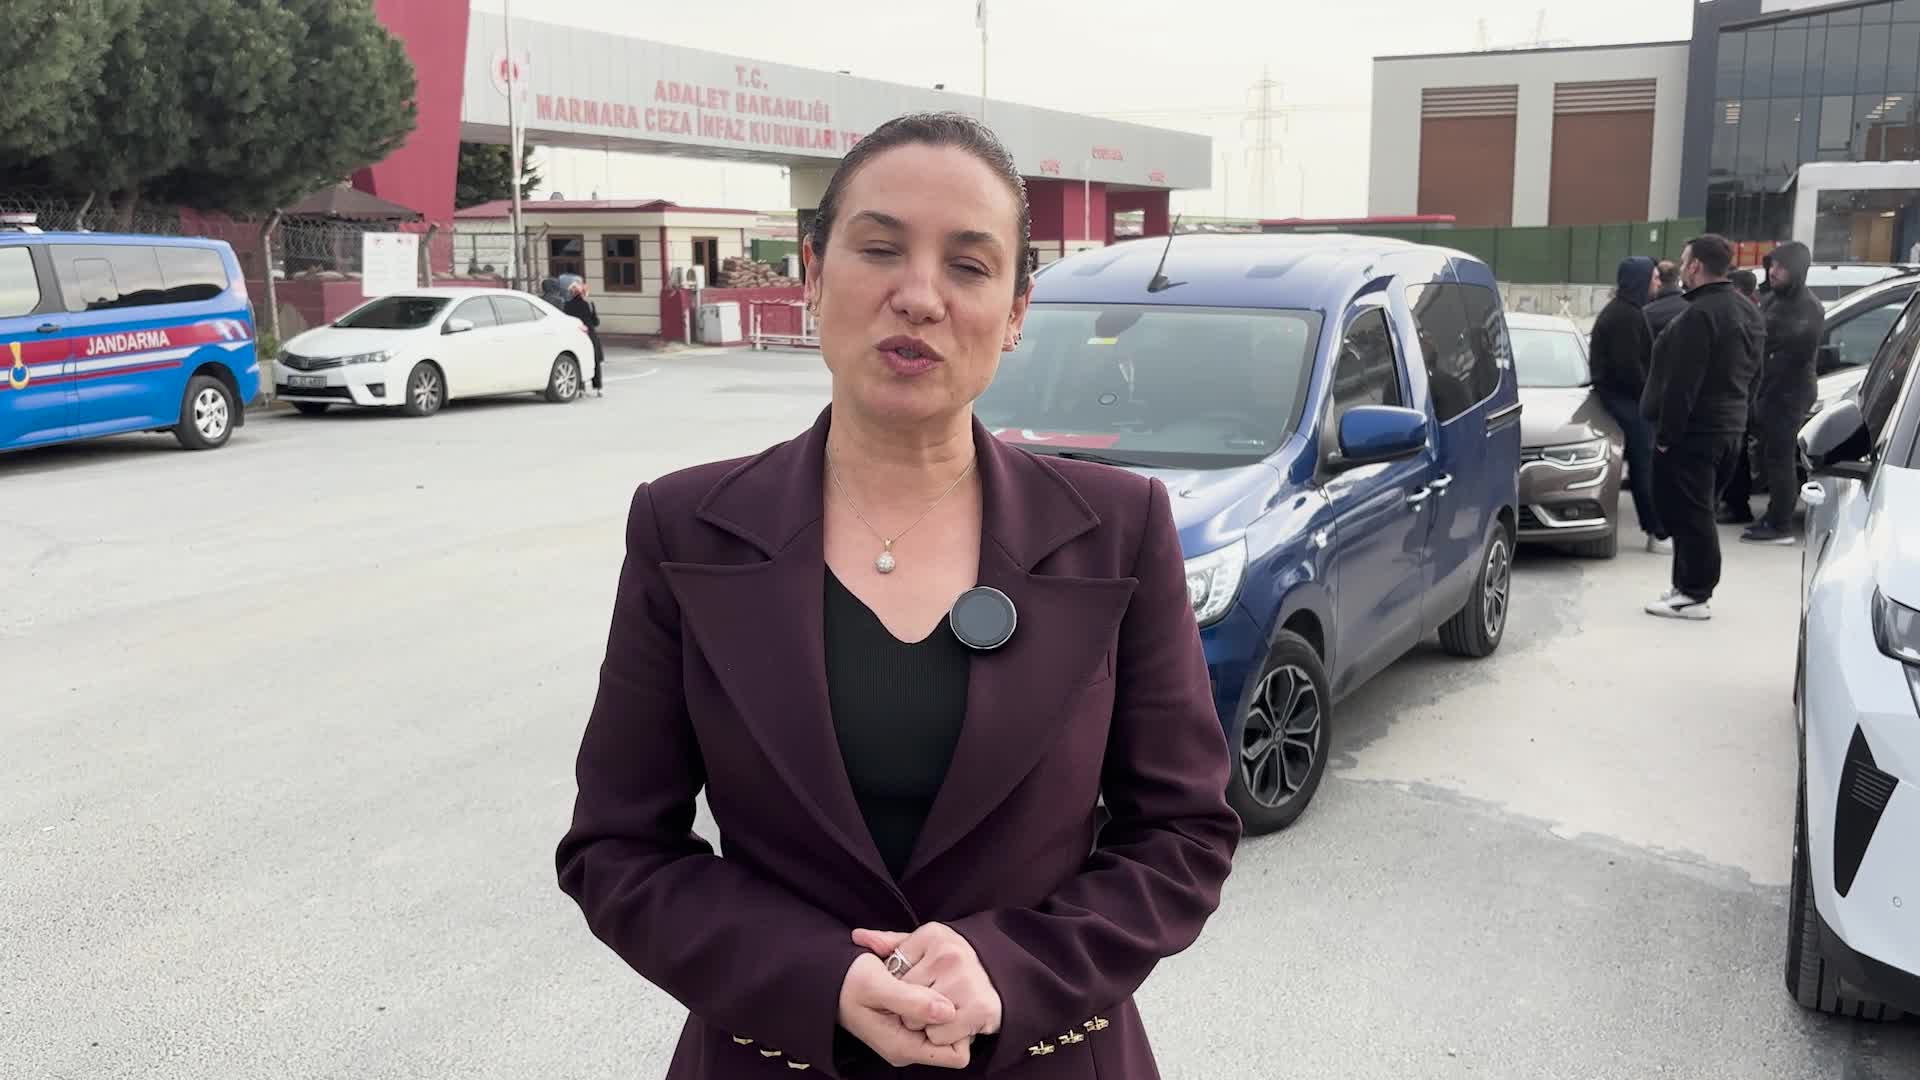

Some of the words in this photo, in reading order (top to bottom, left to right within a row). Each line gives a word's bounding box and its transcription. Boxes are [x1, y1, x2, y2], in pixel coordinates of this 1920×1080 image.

[736, 66, 768, 89] T.C.
[655, 80, 729, 110] ADALET
[736, 93, 830, 123] BAKANLIĞI
[536, 94, 639, 128] MARMARA
[645, 107, 691, 135] CEZA
[697, 109, 745, 141] İNFAZ
[749, 120, 836, 150] KURUMLARI
[87, 331, 169, 355] JANDARMA
